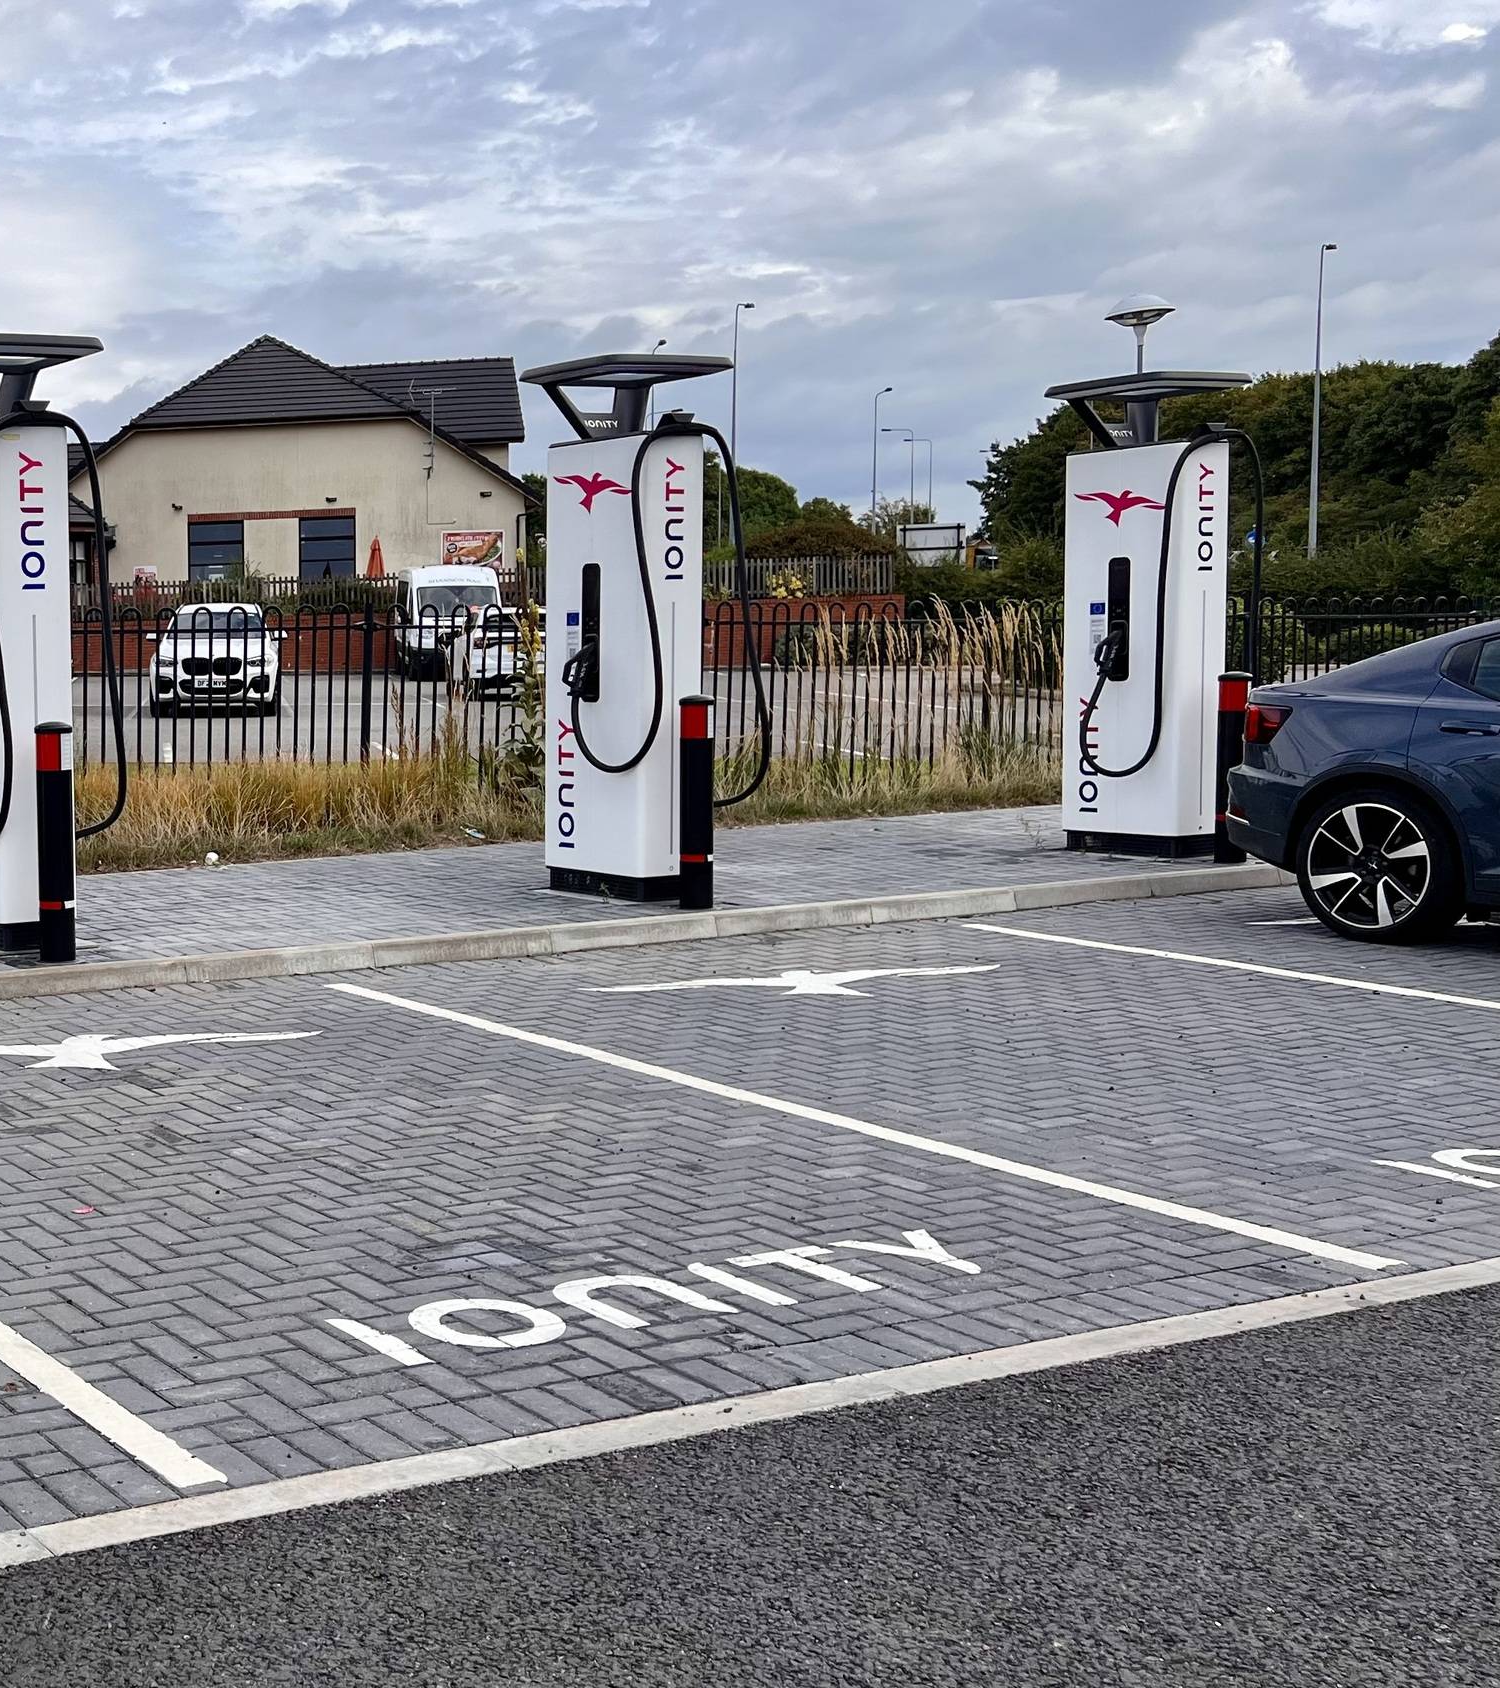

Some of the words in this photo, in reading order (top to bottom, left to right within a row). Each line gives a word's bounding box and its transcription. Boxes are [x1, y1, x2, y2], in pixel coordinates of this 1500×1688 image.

[584, 419, 618, 428] IONITY
[19, 451, 46, 591] IONITY
[665, 457, 685, 580] IONITY
[1198, 462, 1215, 571] IONITY
[558, 718, 576, 849] IONITY
[324, 1229, 982, 1367] IONITY
